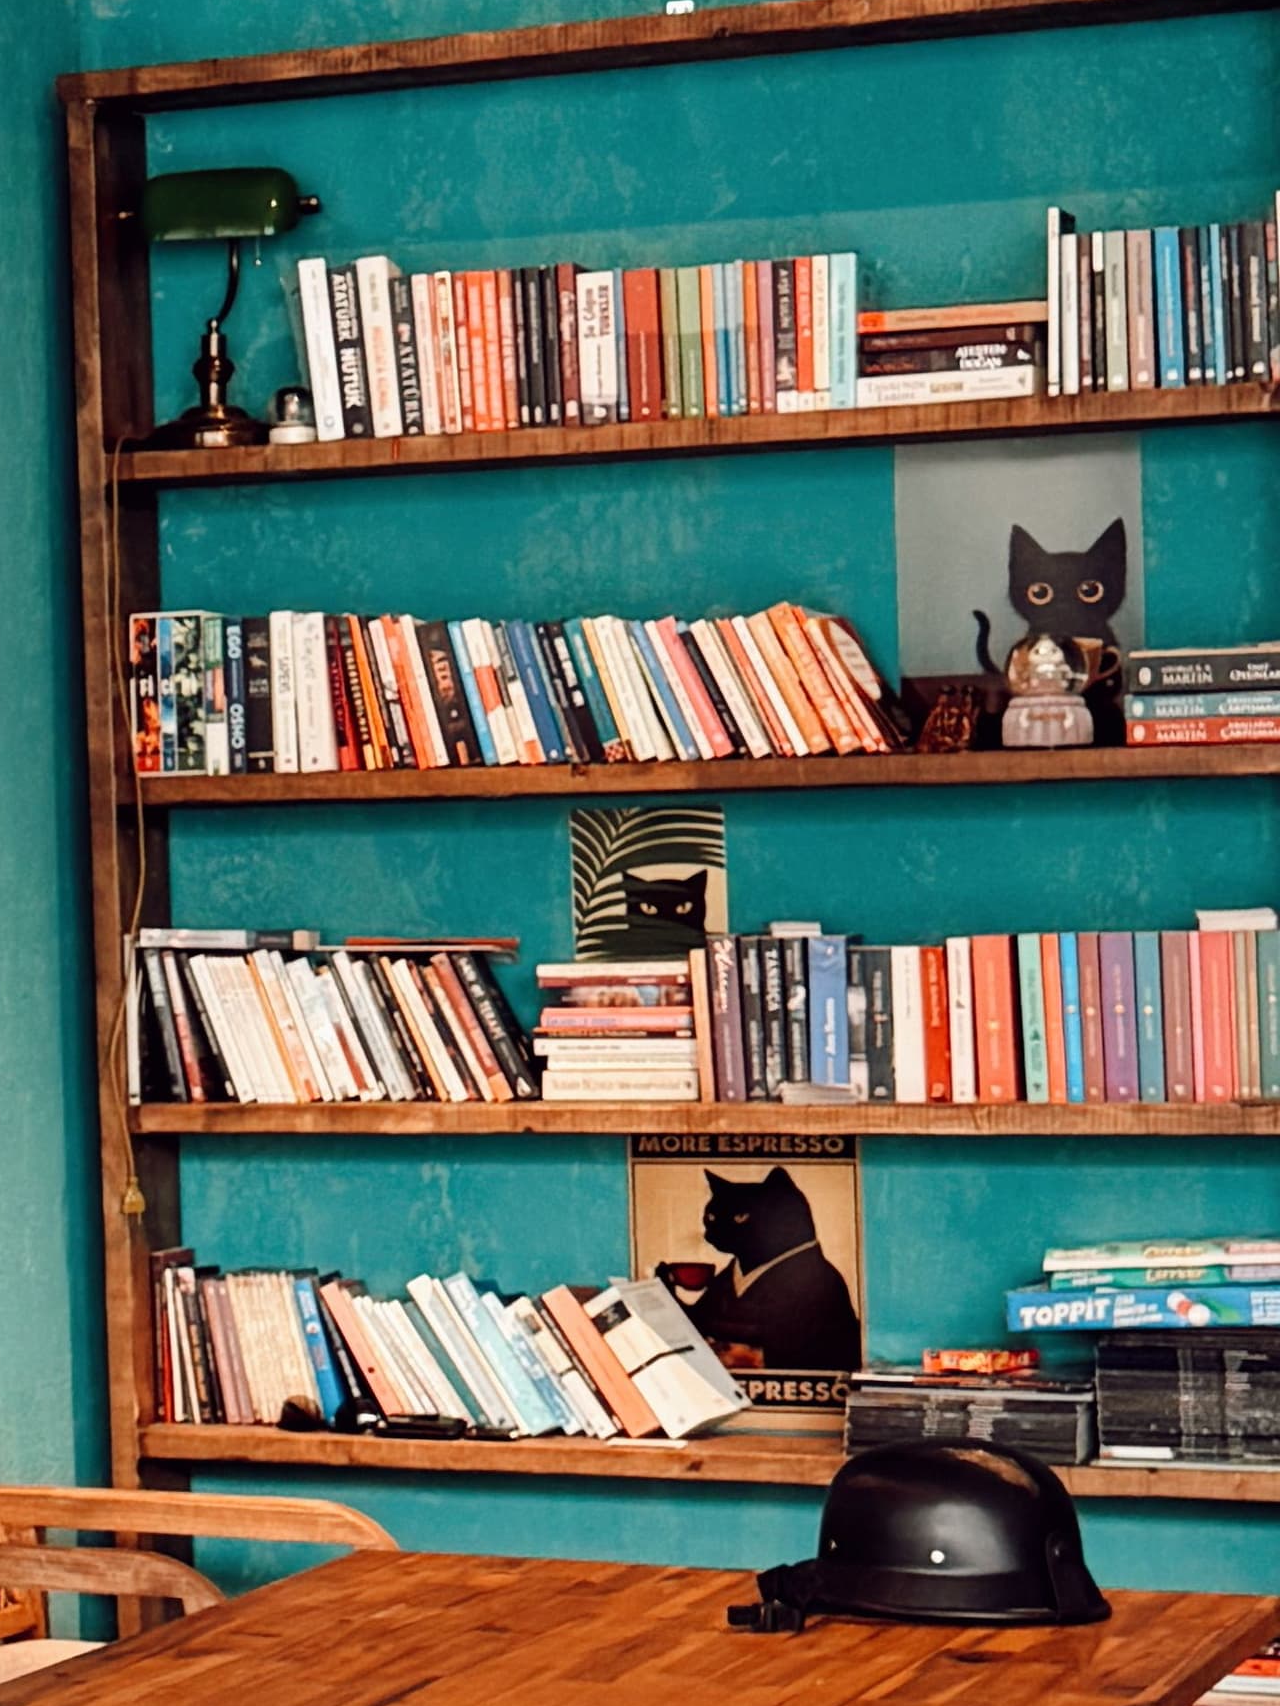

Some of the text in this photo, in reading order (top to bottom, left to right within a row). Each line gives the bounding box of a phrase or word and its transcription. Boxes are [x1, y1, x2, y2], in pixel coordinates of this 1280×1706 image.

[230, 703, 245, 749] OSHO
[639, 1135, 844, 1153] MORE ESPRESSO
[737, 1380, 850, 1402] PRESSO
